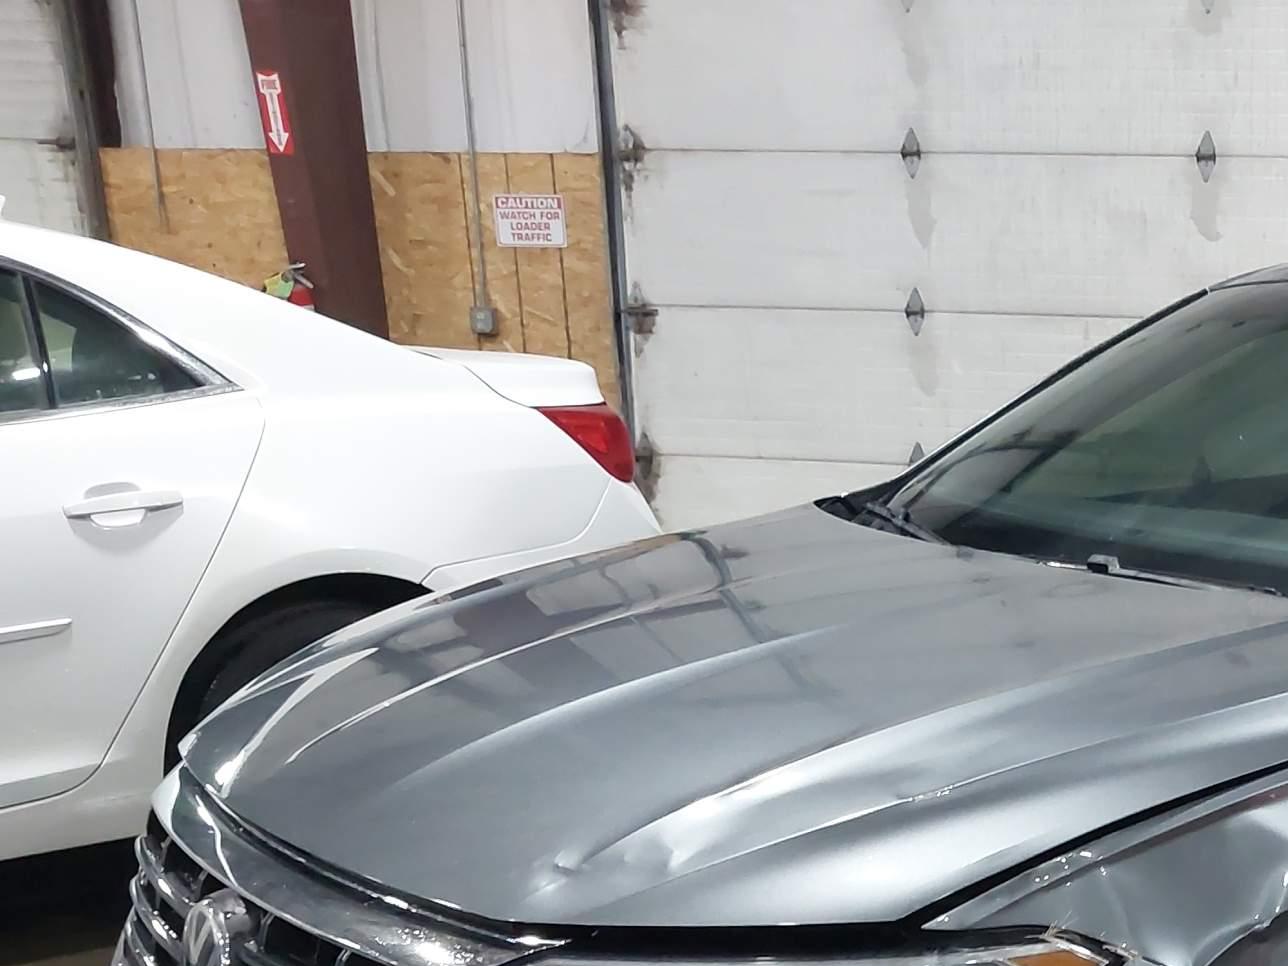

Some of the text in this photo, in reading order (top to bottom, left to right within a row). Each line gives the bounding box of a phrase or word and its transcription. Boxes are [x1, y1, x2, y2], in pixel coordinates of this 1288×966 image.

[497, 197, 558, 208] CAUTION
[499, 211, 560, 220] WATCH FOR
[510, 222, 551, 231] LOADER
[511, 233, 552, 242] TRAFFIC
